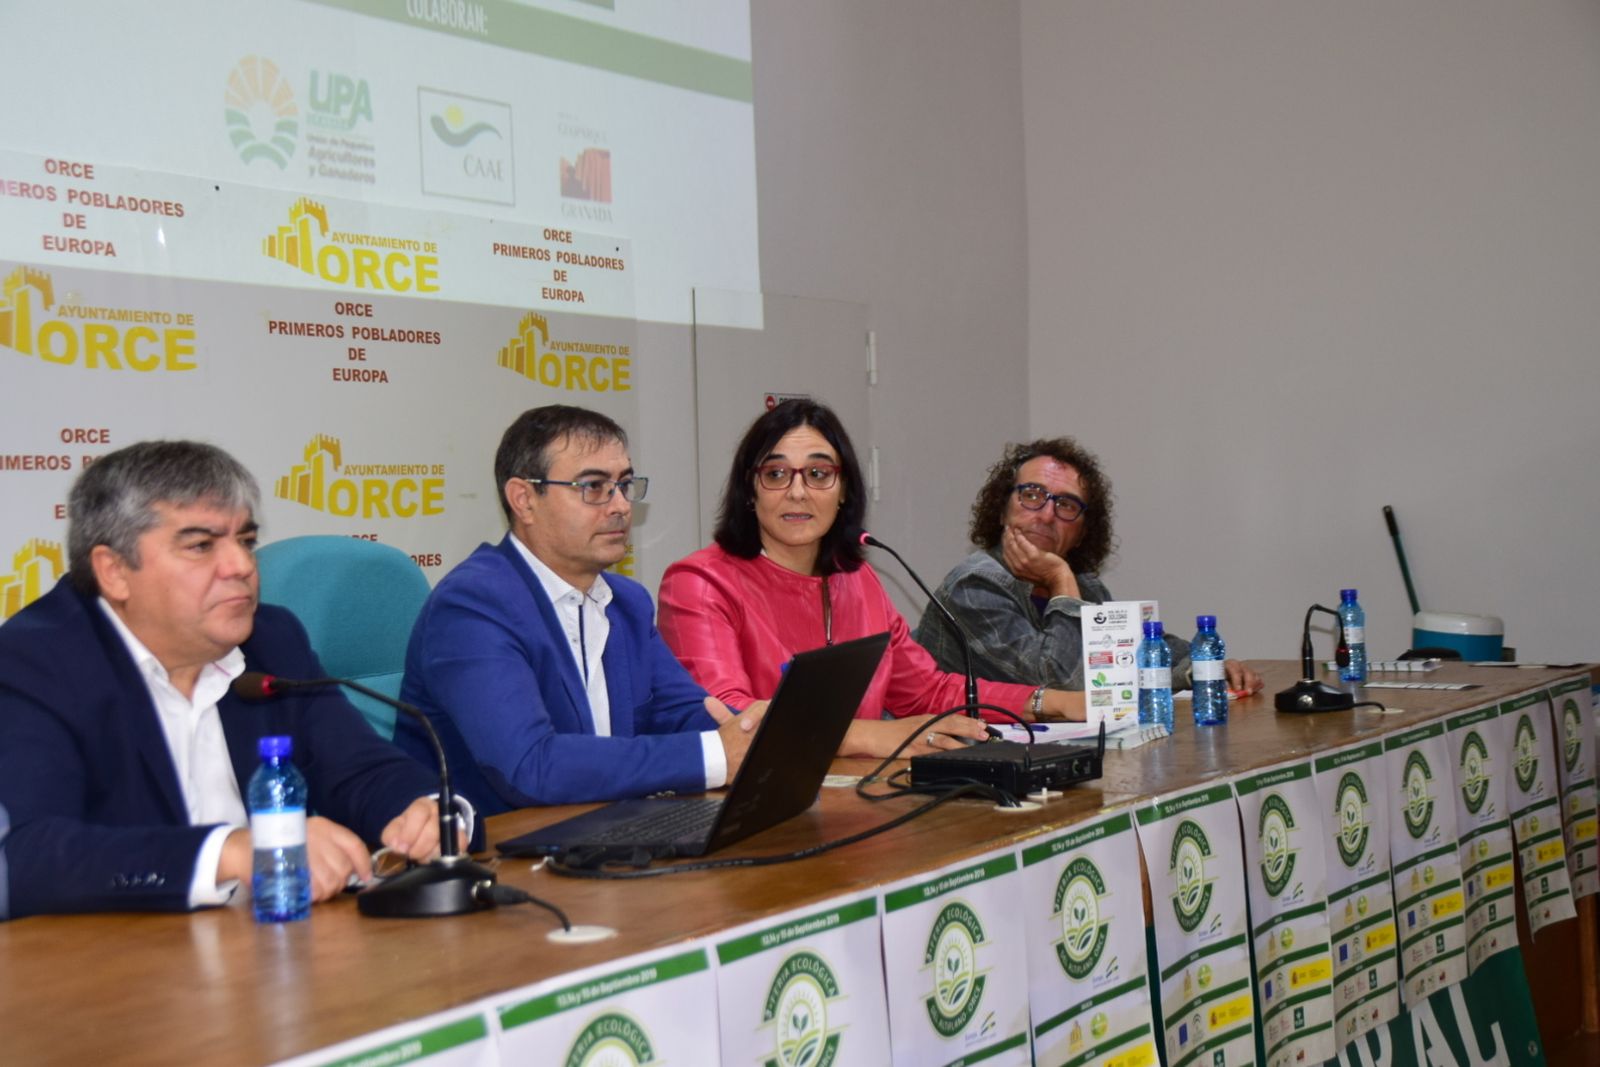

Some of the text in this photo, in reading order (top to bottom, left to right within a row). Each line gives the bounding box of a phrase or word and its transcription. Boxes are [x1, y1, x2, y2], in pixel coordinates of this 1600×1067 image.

[406, 0, 488, 36] COLABORAN:
[308, 69, 374, 129] UPA
[44, 158, 95, 180] ORCE
[67, 188, 185, 218] POBLADORES
[63, 213, 87, 229] DE
[42, 235, 117, 257] EUROPA
[331, 231, 438, 254] AYUNTAMIENTO DE
[543, 227, 573, 244] ORCE
[493, 242, 625, 271] PRIMEROS POBLADORES
[317, 245, 441, 293] ORCE
[553, 269, 568, 283] DE
[541, 287, 585, 303] EUROPA
[58, 304, 195, 326] AYUNTAMIENTO DE
[334, 301, 374, 318] ORCE
[268, 320, 442, 345] PRIMEROS POBLADORES
[37, 320, 198, 373] ORCE
[348, 347, 367, 362] DE
[550, 341, 630, 356] AYUNTAMIENTO DE
[332, 367, 389, 384] EUROPA
[538, 353, 632, 392] ORCE
[61, 428, 110, 444] ORCE
[343, 464, 446, 477] AYUNTAMIENTO DE
[327, 478, 446, 520] ORCE
